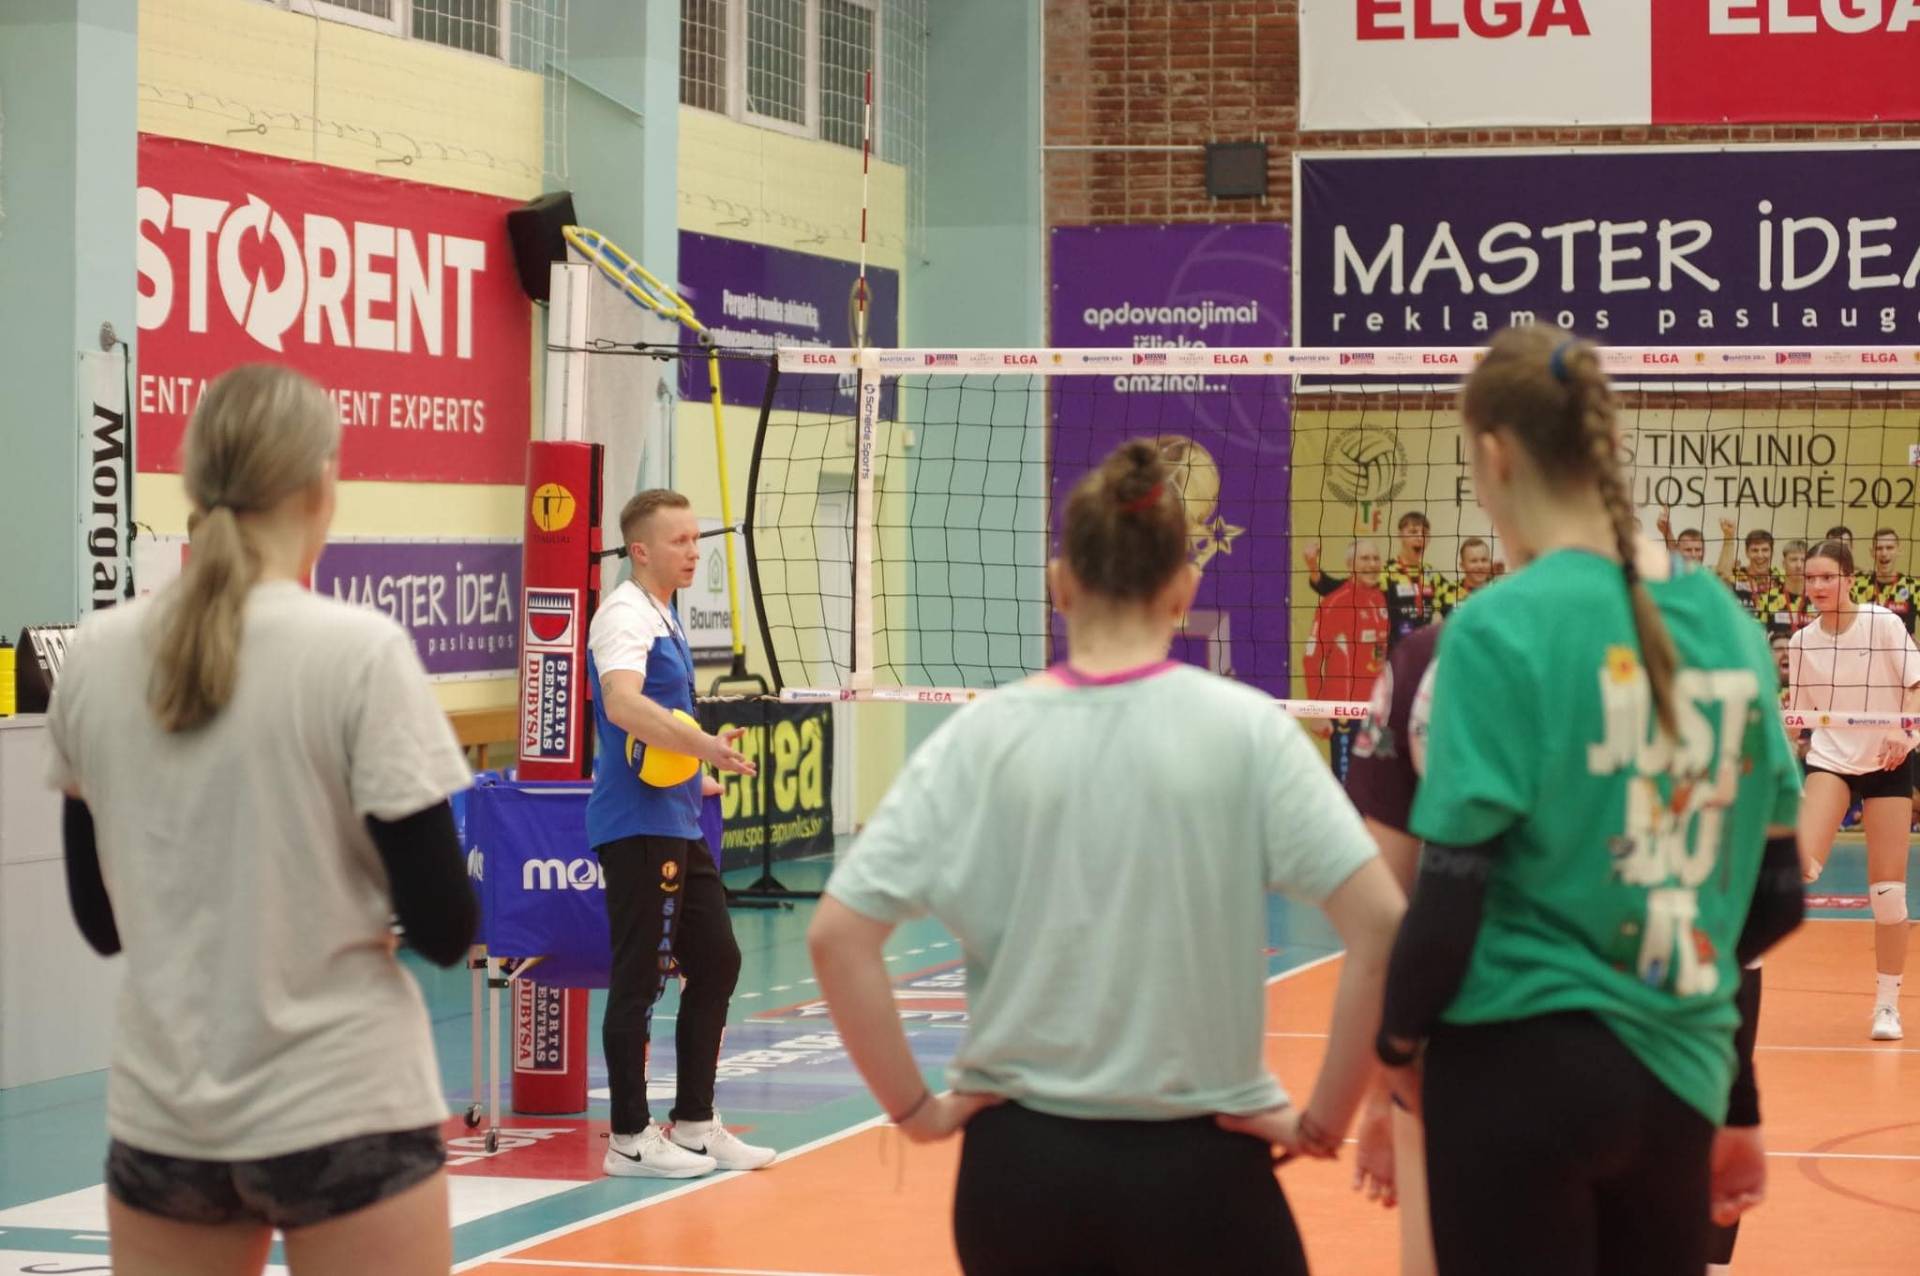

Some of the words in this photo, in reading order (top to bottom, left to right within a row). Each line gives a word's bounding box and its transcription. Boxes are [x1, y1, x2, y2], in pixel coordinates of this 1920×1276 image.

[1356, 0, 1591, 41] ELGA
[137, 187, 486, 360] STORENT
[1333, 218, 1721, 296] MASTER
[1084, 301, 1258, 331] apdovanojimai
[1333, 306, 1610, 332] reklamos
[1658, 303, 1920, 335] paslaug
[803, 354, 837, 365] ELGA
[1004, 354, 1038, 365] ELGA
[1214, 354, 1248, 365] ELGA
[1423, 354, 1458, 365] ELGA
[1643, 353, 1679, 364] ELGA
[1862, 353, 1898, 364] ELGA
[390, 395, 485, 434] EXPERTS
[862, 442, 871, 480] Sports
[1645, 433, 1836, 466] TINKLINIO
[1715, 470, 1836, 508] TAURĖ
[334, 574, 448, 628] MASTER
[429, 633, 515, 656] paslaugos
[526, 659, 541, 748] DUBYSA
[542, 659, 556, 750] CENTRAS
[554, 660, 568, 751] SPORTO
[918, 692, 951, 702] ELGA
[1334, 706, 1368, 716] ELGA
[1586, 667, 1759, 805] JUST
[1620, 777, 1723, 888] DO
[535, 986, 548, 1064] ENTRAS
[548, 988, 562, 1064] PORTO
